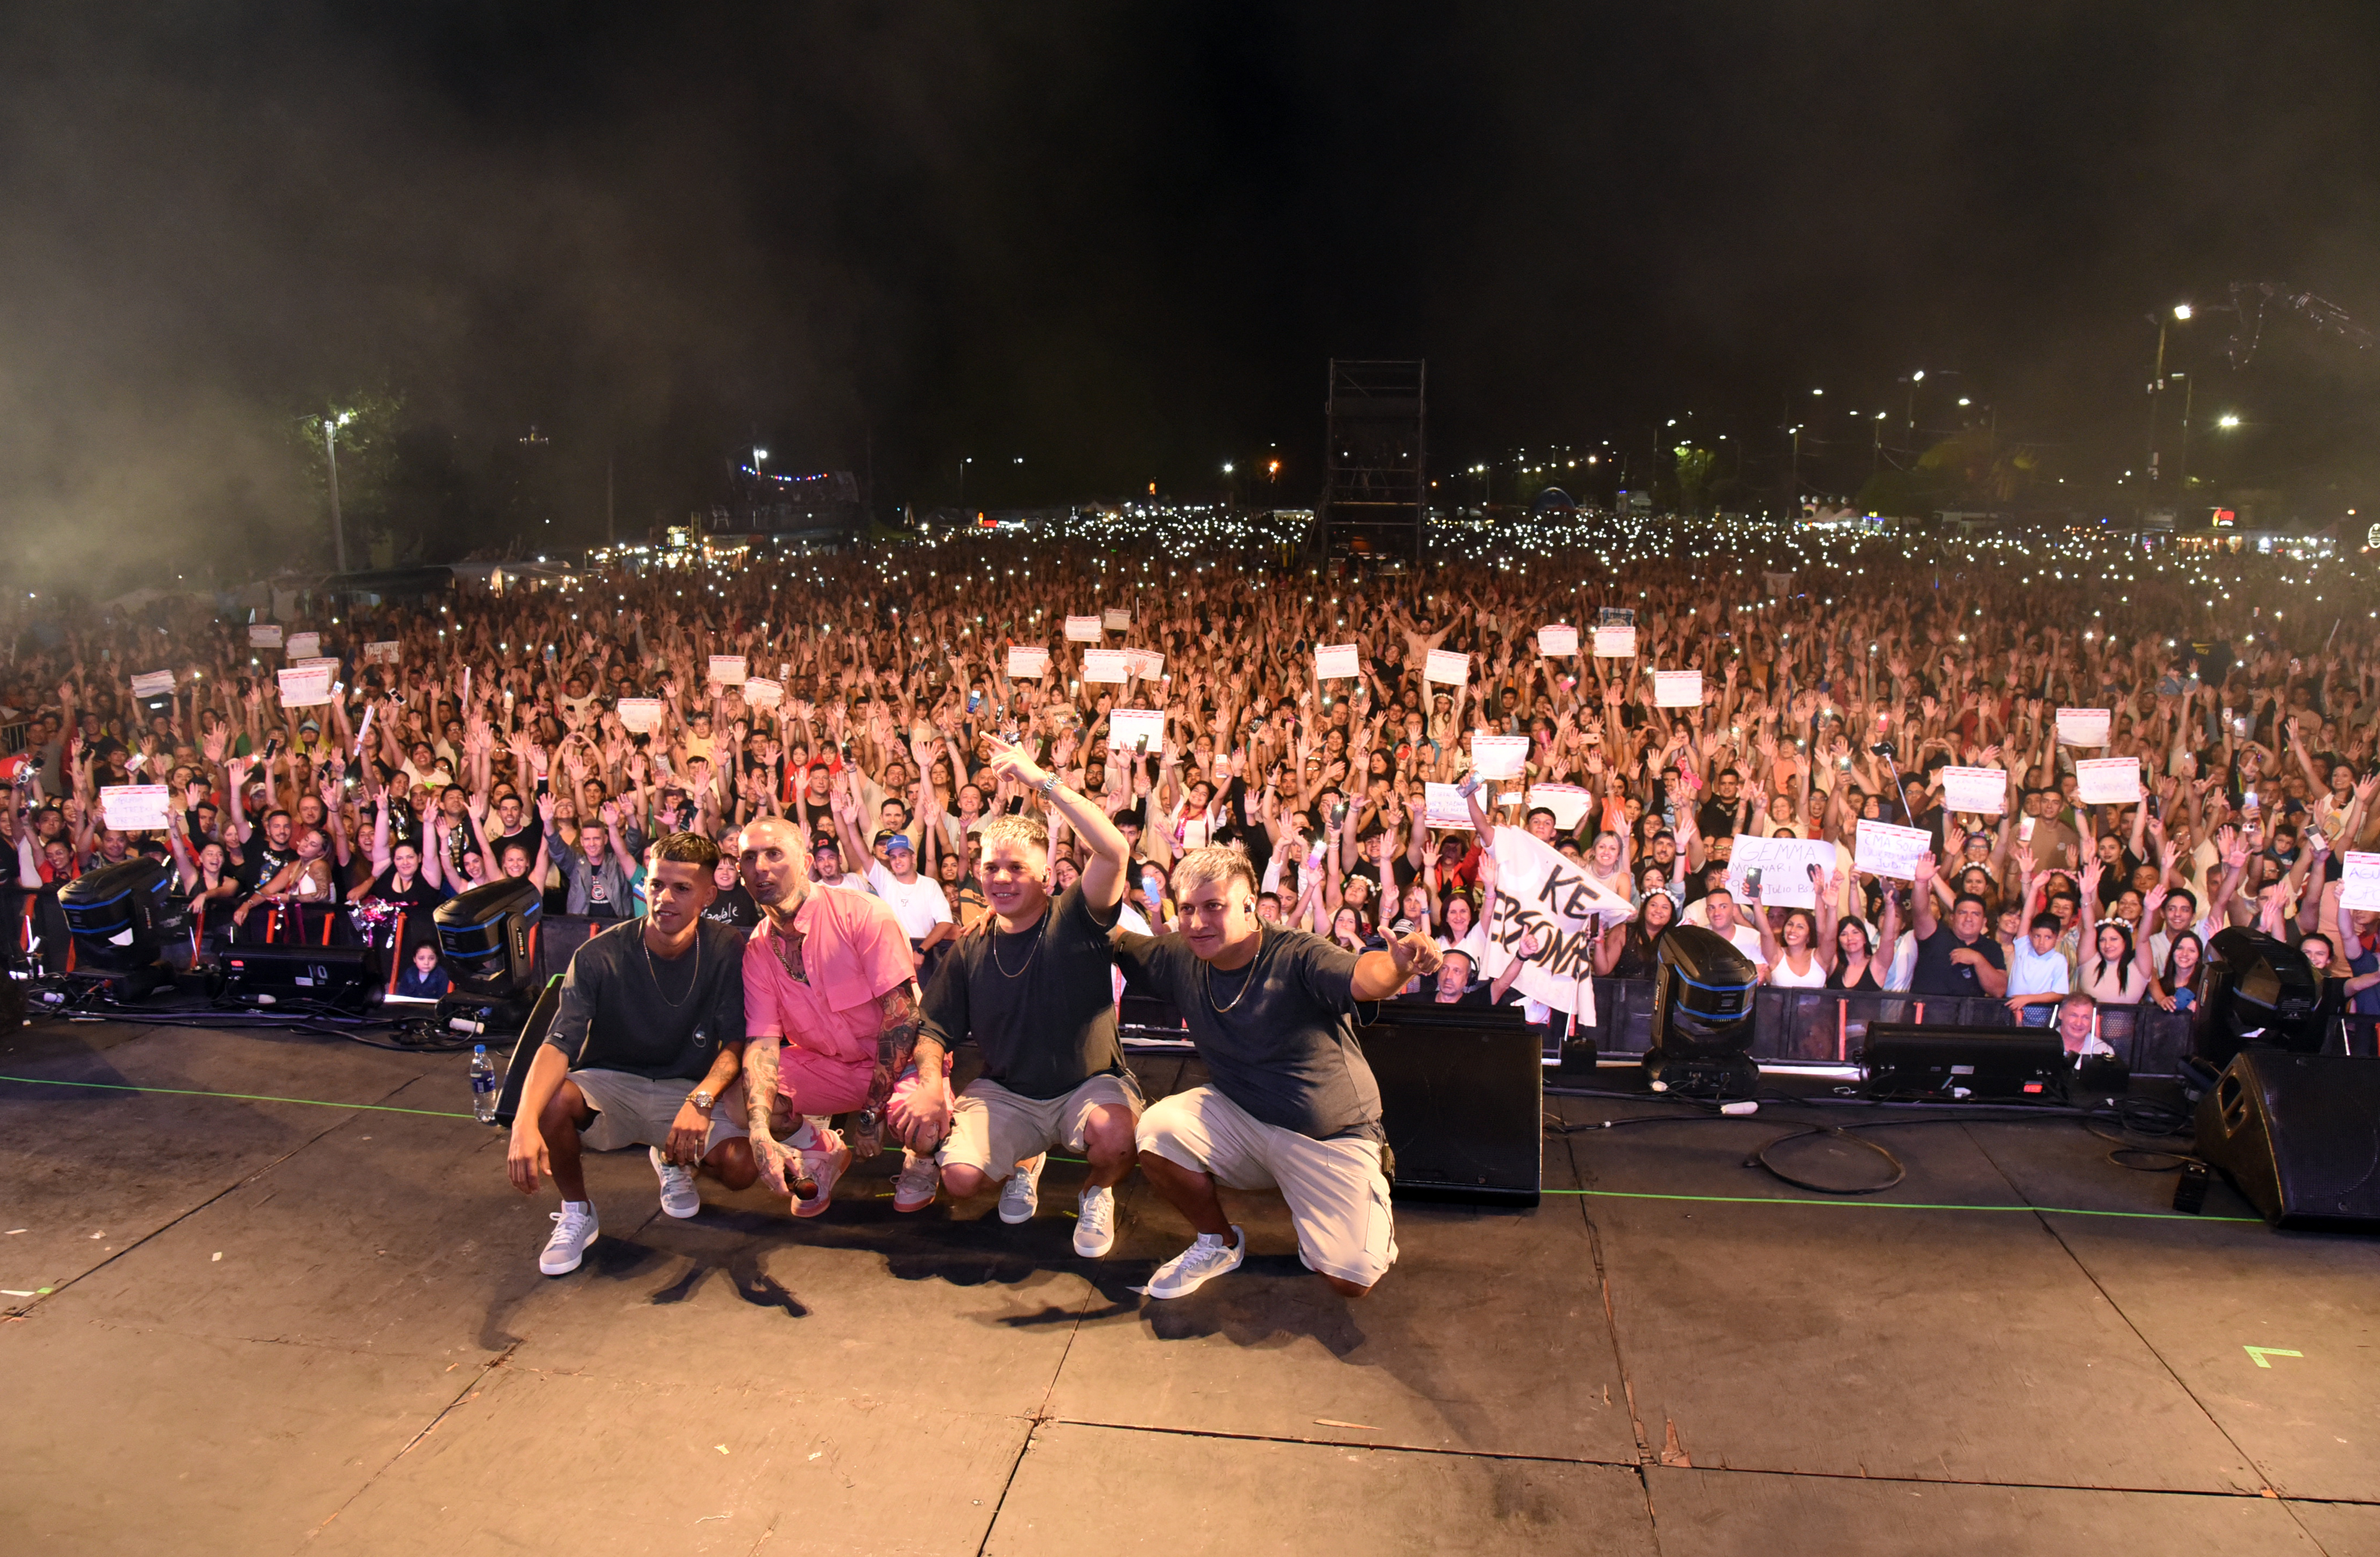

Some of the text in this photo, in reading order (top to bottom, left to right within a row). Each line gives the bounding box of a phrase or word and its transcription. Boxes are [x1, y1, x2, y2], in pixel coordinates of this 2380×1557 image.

[1739, 841, 1816, 862] GEMMA
[1865, 833, 1925, 852] EMA SOLO
[1538, 864, 1601, 920] KE
[1764, 883, 1791, 895] JULIO
